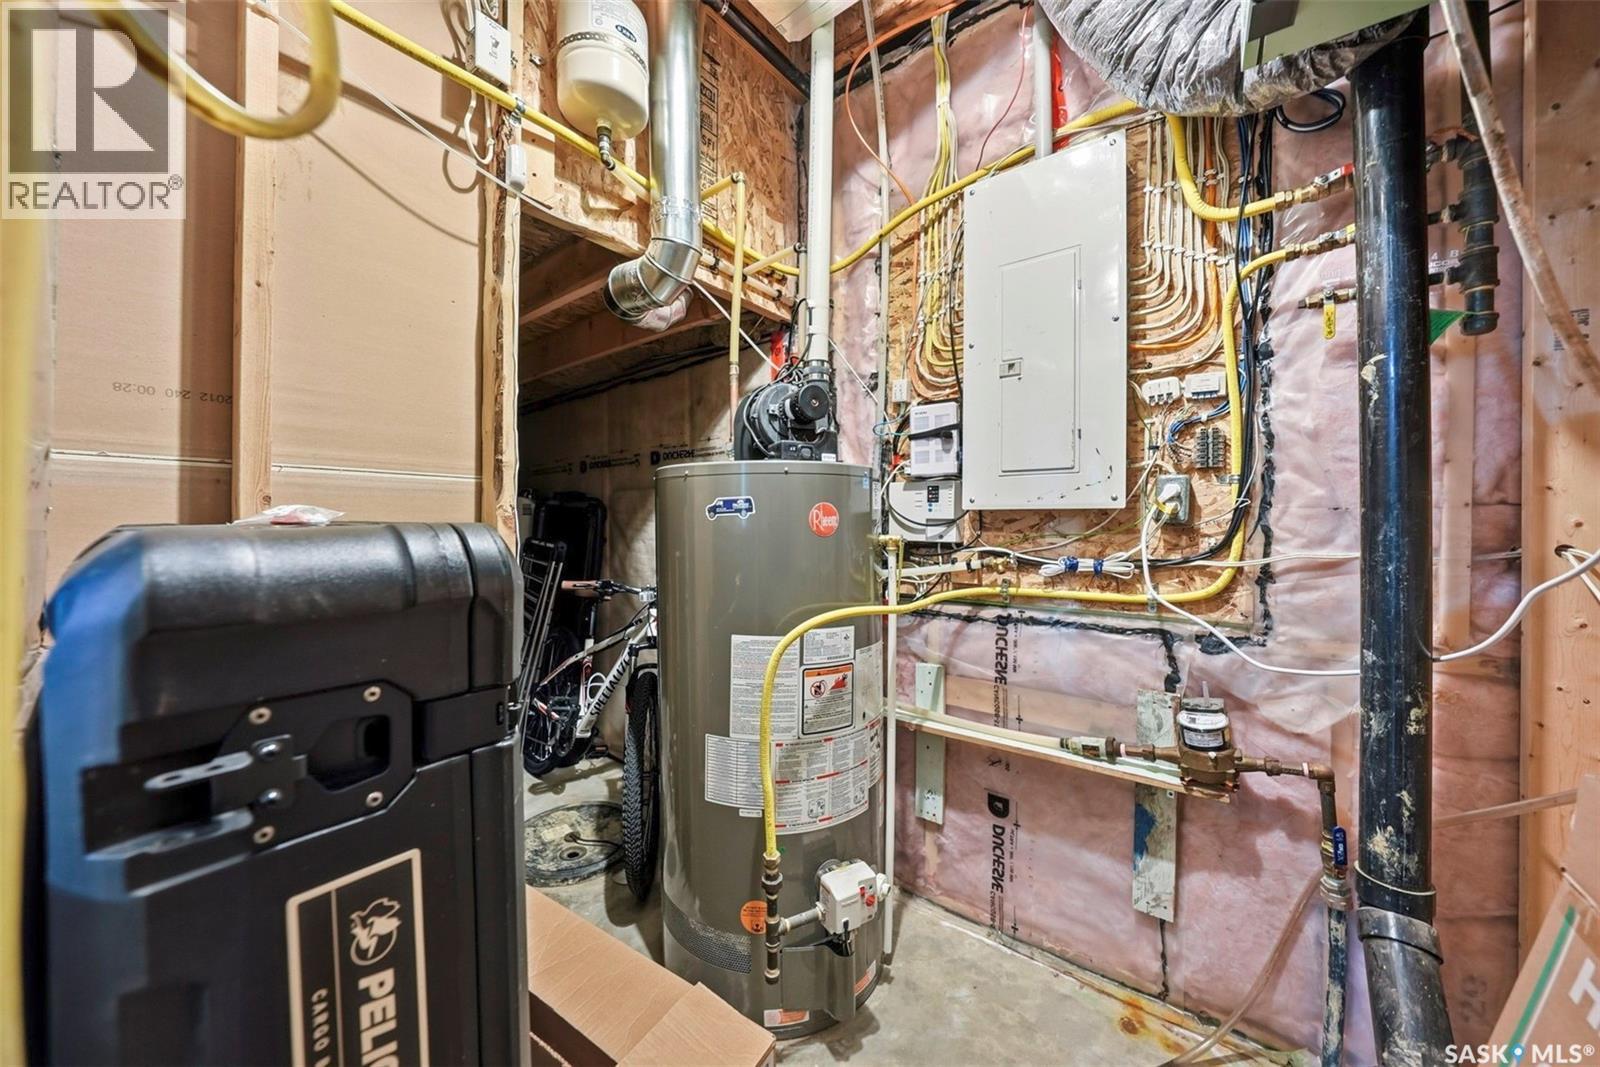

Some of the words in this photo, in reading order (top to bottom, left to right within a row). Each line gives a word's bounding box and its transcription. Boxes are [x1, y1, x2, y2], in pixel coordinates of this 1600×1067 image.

[112, 381, 156, 396] 00:28
[164, 387, 191, 400] 240
[199, 391, 233, 405] 2012
[812, 503, 839, 532] Rheem
[311, 987, 331, 1052] CARGO
